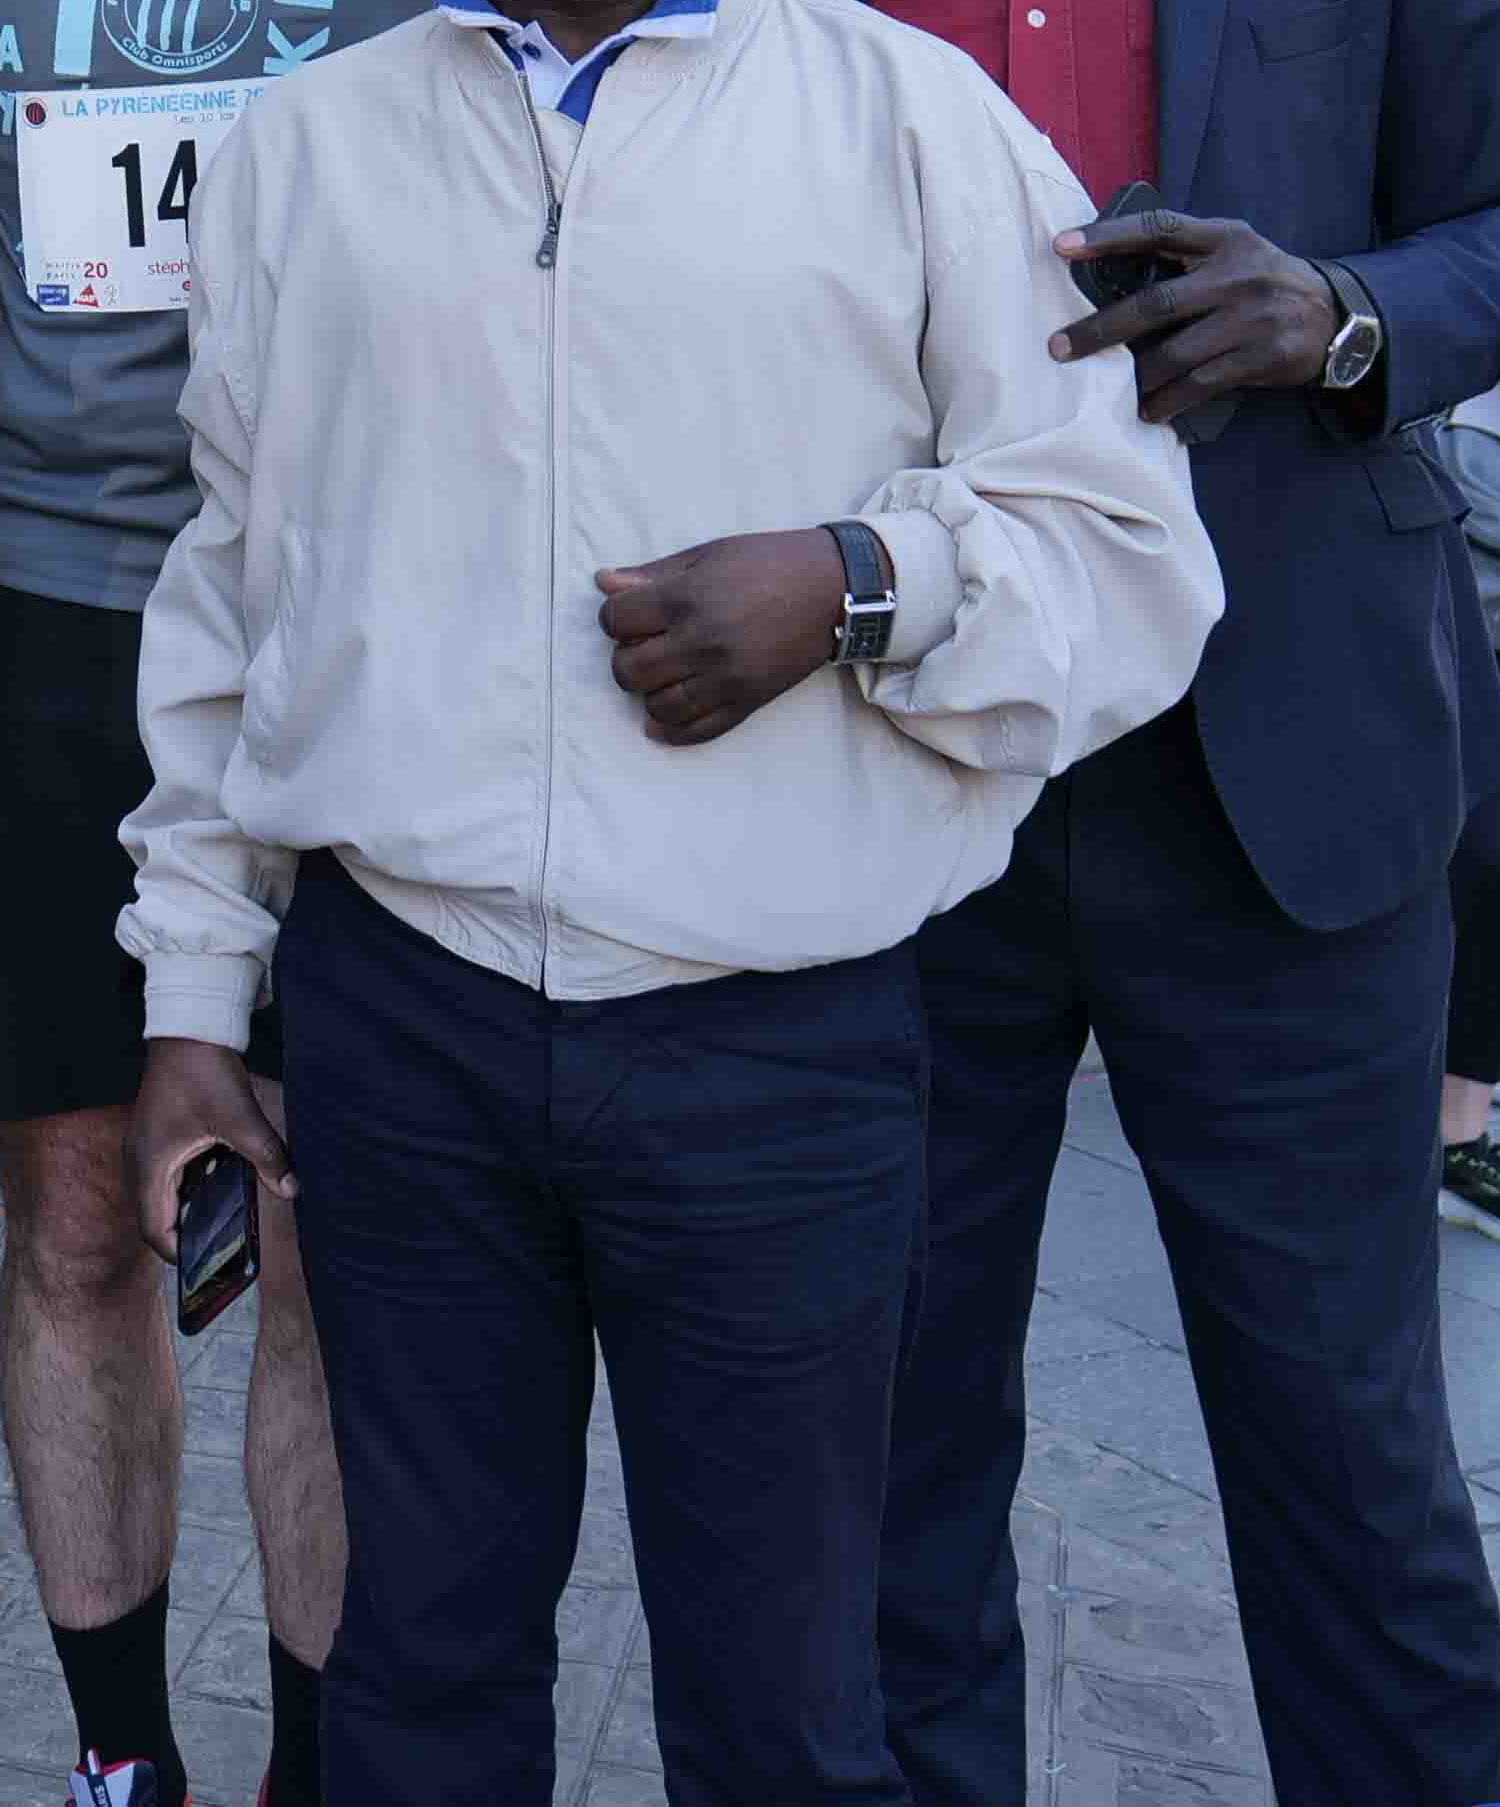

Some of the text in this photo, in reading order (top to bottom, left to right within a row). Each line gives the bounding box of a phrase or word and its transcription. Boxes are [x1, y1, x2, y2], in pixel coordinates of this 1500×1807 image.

[122, 37, 228, 67] Club Omnisports
[62, 97, 89, 117] LA
[111, 139, 199, 248] 14
[83, 261, 108, 279] 20
